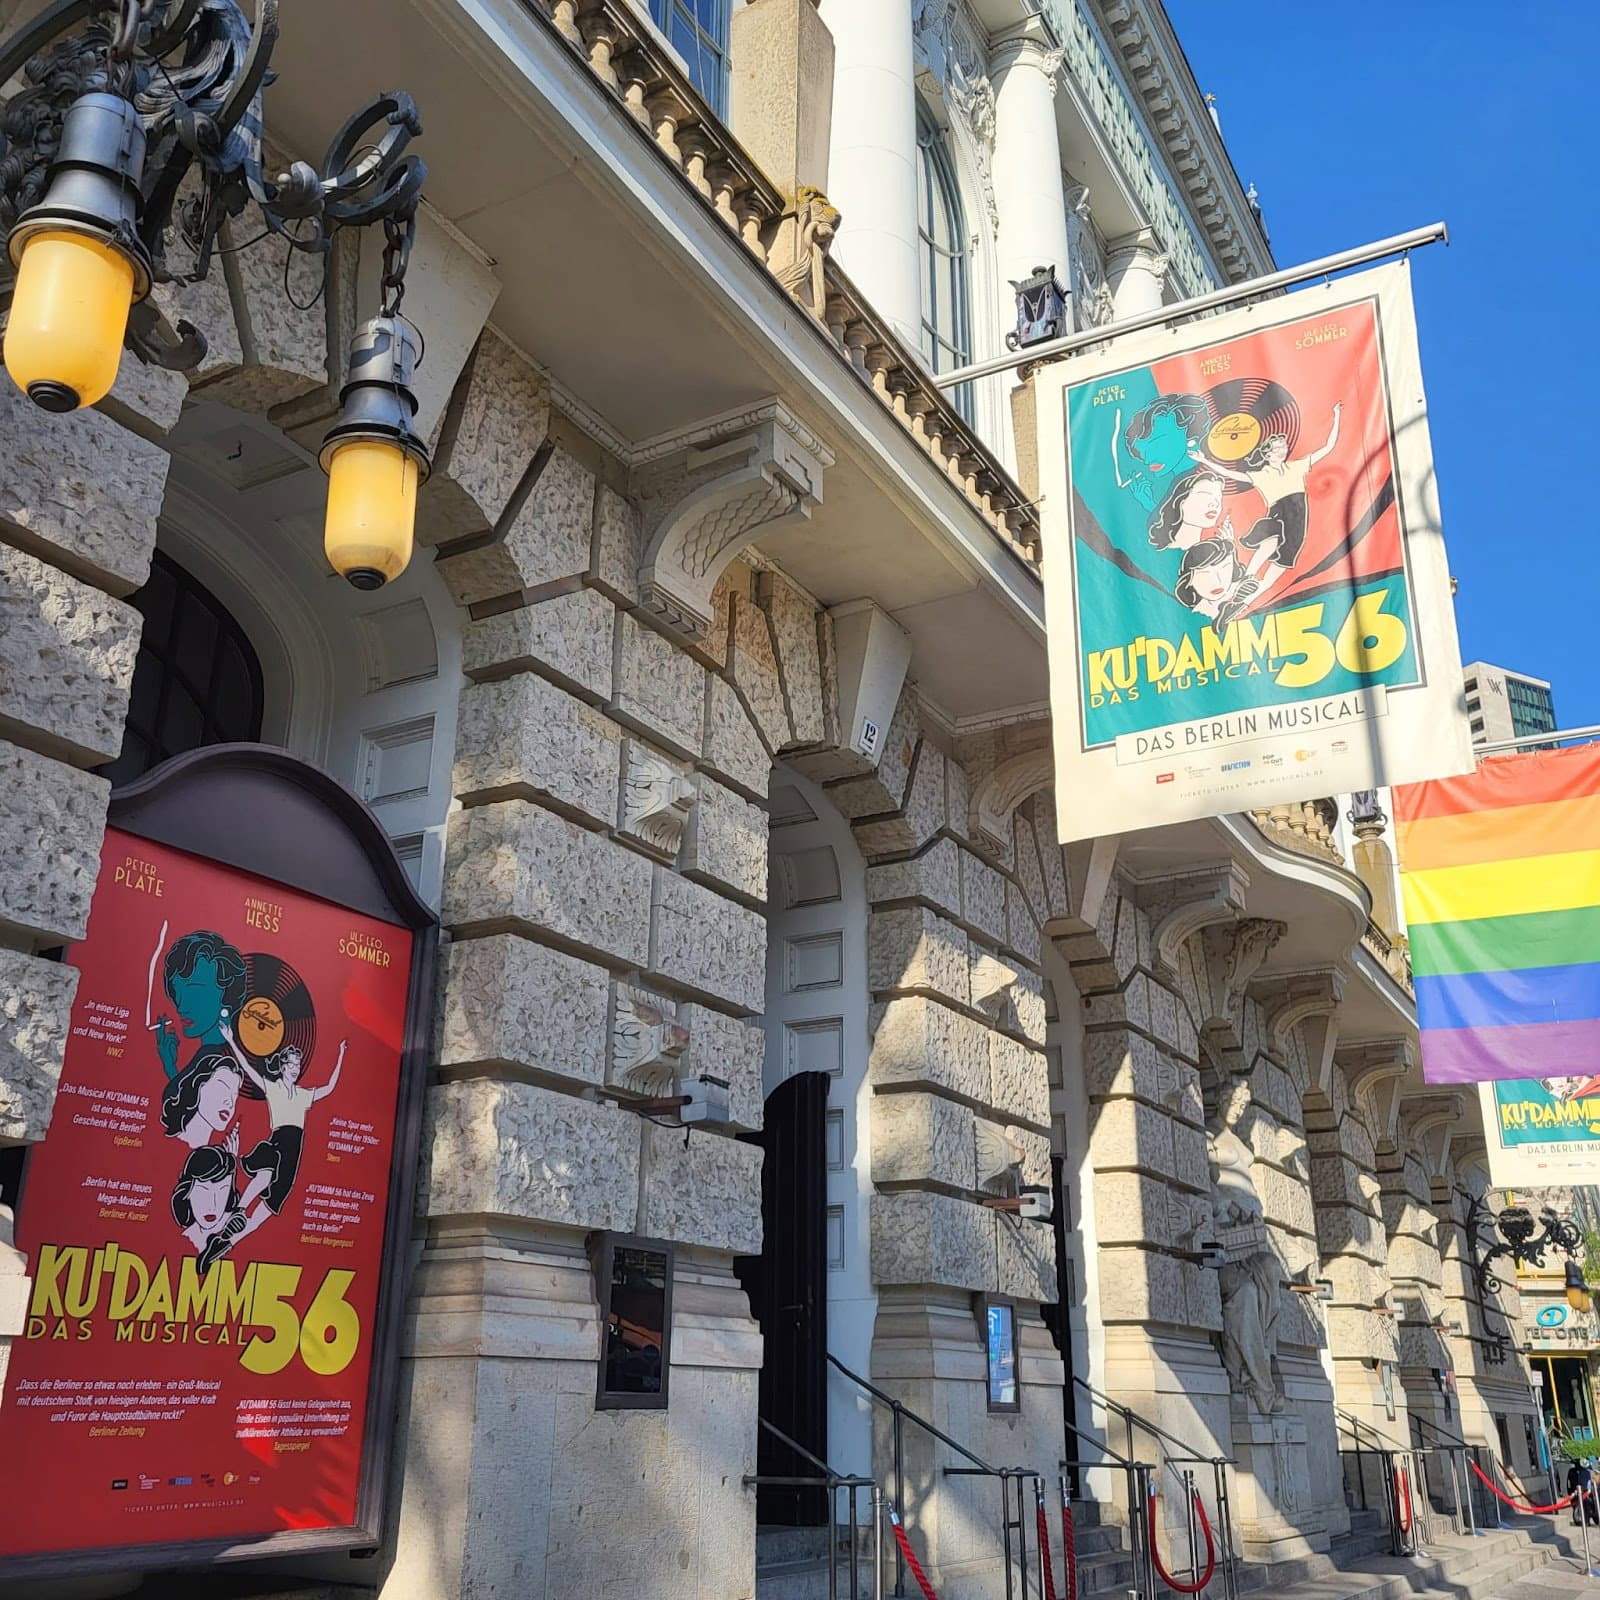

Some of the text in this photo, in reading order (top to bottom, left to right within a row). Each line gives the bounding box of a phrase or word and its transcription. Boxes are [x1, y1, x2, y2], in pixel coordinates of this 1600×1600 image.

[1296, 328, 1348, 350] SOMMER
[1202, 362, 1232, 376] HESS
[1094, 390, 1126, 407] PLATE
[1098, 384, 1120, 396] PETER
[1088, 589, 1406, 694] KU'DAMM 56
[1090, 658, 1281, 709] DAS MUSICAL
[864, 724, 876, 744] 12
[1136, 696, 1364, 755] DAS BERLIN MUSICAL
[124, 856, 158, 877] PETER
[114, 866, 165, 897] PLATE
[244, 897, 283, 918] ANNETTE
[246, 911, 280, 934] HESS
[350, 931, 383, 949] ULF LEO
[338, 938, 391, 969] SOMMER
[96, 1004, 114, 1015] einer
[114, 1006, 129, 1018] Liga
[89, 1016, 128, 1031] mit London
[73, 1026, 88, 1036] und
[88, 1028, 105, 1040] New
[106, 1047, 124, 1058] NWZ
[78, 1085, 106, 1099] Musical
[140, 1096, 150, 1107] 56
[91, 1104, 147, 1121] ist ein doppeltes
[73, 1114, 107, 1128] Geschenk
[108, 1118, 119, 1130] für
[347, 1120, 360, 1130] Spur
[360, 1124, 374, 1132] mehr
[1550, 1144, 1583, 1152] BERLIN
[107, 1180, 119, 1190] hat
[120, 1181, 131, 1190] ein
[132, 1184, 152, 1194] neues
[99, 1208, 128, 1219] Berliner
[30, 1242, 360, 1376] KU'DAMM 56
[26, 1317, 247, 1346] DAS MUSICAL
[40, 1379, 53, 1390] die
[53, 1379, 82, 1390] Berliner
[83, 1381, 93, 1390] so
[94, 1380, 115, 1390] etwas
[117, 1380, 134, 1390] noch
[135, 1380, 161, 1390] erleben
[166, 1380, 177, 1390] ein
[17, 1396, 29, 1406] mit
[31, 1395, 73, 1406] deutschem
[94, 1397, 108, 1405] von
[108, 1395, 138, 1408] hiesigen
[168, 1395, 181, 1405] das
[182, 1395, 200, 1405] voller
[200, 1395, 216, 1405] Kraft
[51, 1411, 65, 1422] und
[67, 1411, 88, 1422] Furor
[88, 1410, 100, 1421] die
[101, 1410, 160, 1422] Hauptstadtbühne
[89, 1426, 146, 1438] Berliner Zeitung
